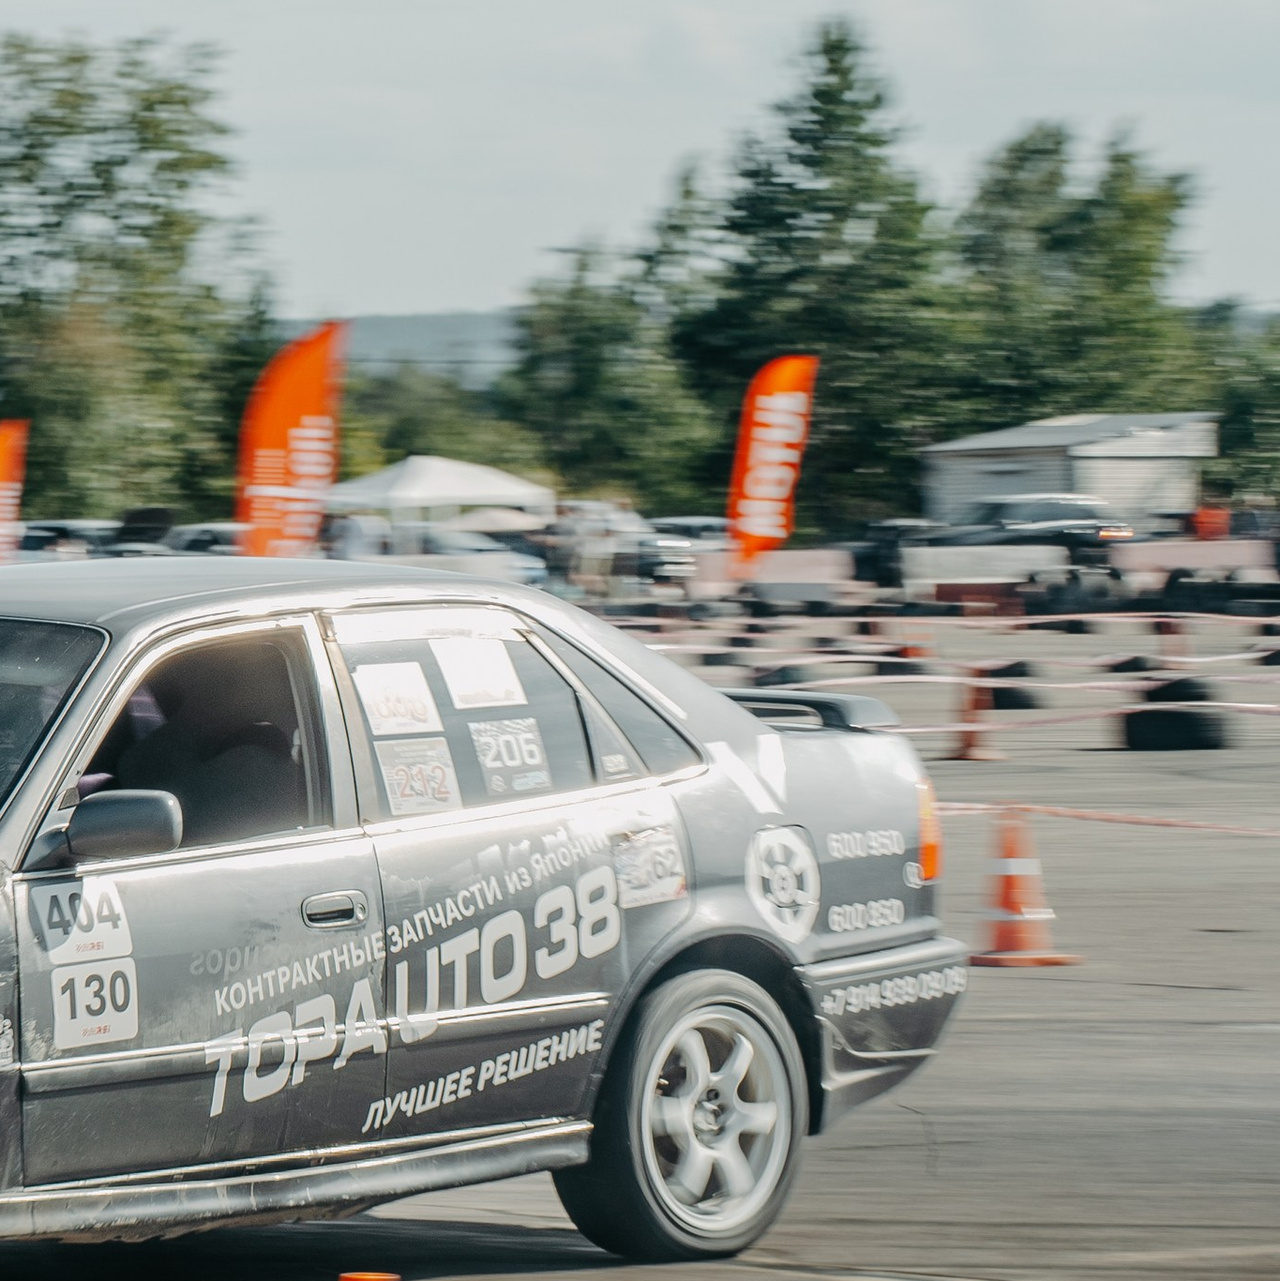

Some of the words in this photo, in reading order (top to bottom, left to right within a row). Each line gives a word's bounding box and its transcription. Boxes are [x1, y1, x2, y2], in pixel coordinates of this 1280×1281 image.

[736, 391, 809, 539] MOTUL
[479, 733, 543, 769] 206
[396, 765, 451, 799] 212
[47, 891, 122, 935] 404
[215, 931, 387, 1016] КОНТРАКТНЫЕ
[388, 875, 504, 954] ЗАПЧАСТИ
[505, 867, 533, 894] из
[60, 970, 131, 1021] 130
[361, 1065, 476, 1133] ЛУЧШЕЕ
[477, 1019, 605, 1092] РЕШЕНИЕ
